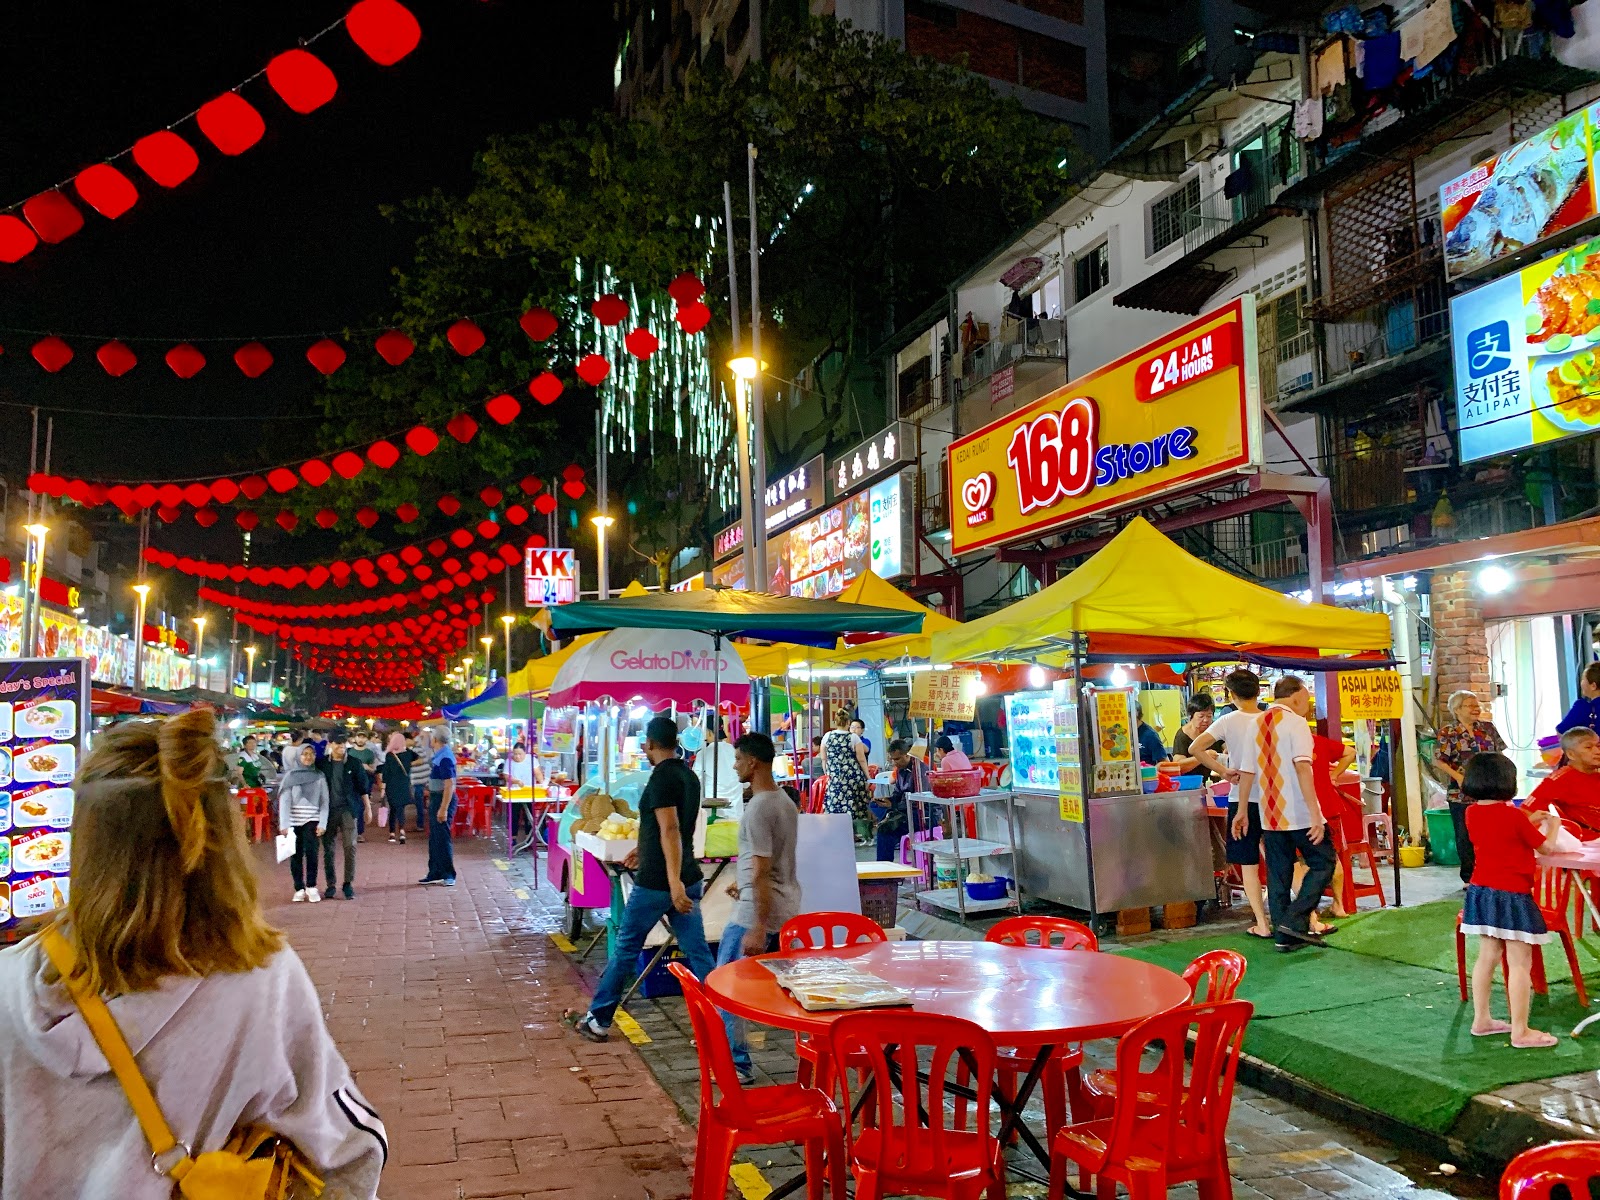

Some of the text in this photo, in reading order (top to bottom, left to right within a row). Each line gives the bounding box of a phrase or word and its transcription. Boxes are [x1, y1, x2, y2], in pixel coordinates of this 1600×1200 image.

[1445, 178, 1493, 207] Tiger Grouper
[1182, 335, 1212, 364] JAM
[1149, 350, 1213, 395] 24 HOURS
[1462, 369, 1521, 408] 支付宝
[1466, 393, 1521, 419] ALIPAY
[1007, 397, 1196, 516] 168 Store
[967, 510, 987, 525] WALL'S
[531, 549, 570, 577] KK
[544, 578, 557, 603] 24
[33, 671, 76, 688] Special
[928, 675, 960, 688] 三间庄
[1341, 675, 1401, 693] ASAM LAKSA
[19, 830, 42, 844] rm 13
[19, 875, 42, 889] rm 16
